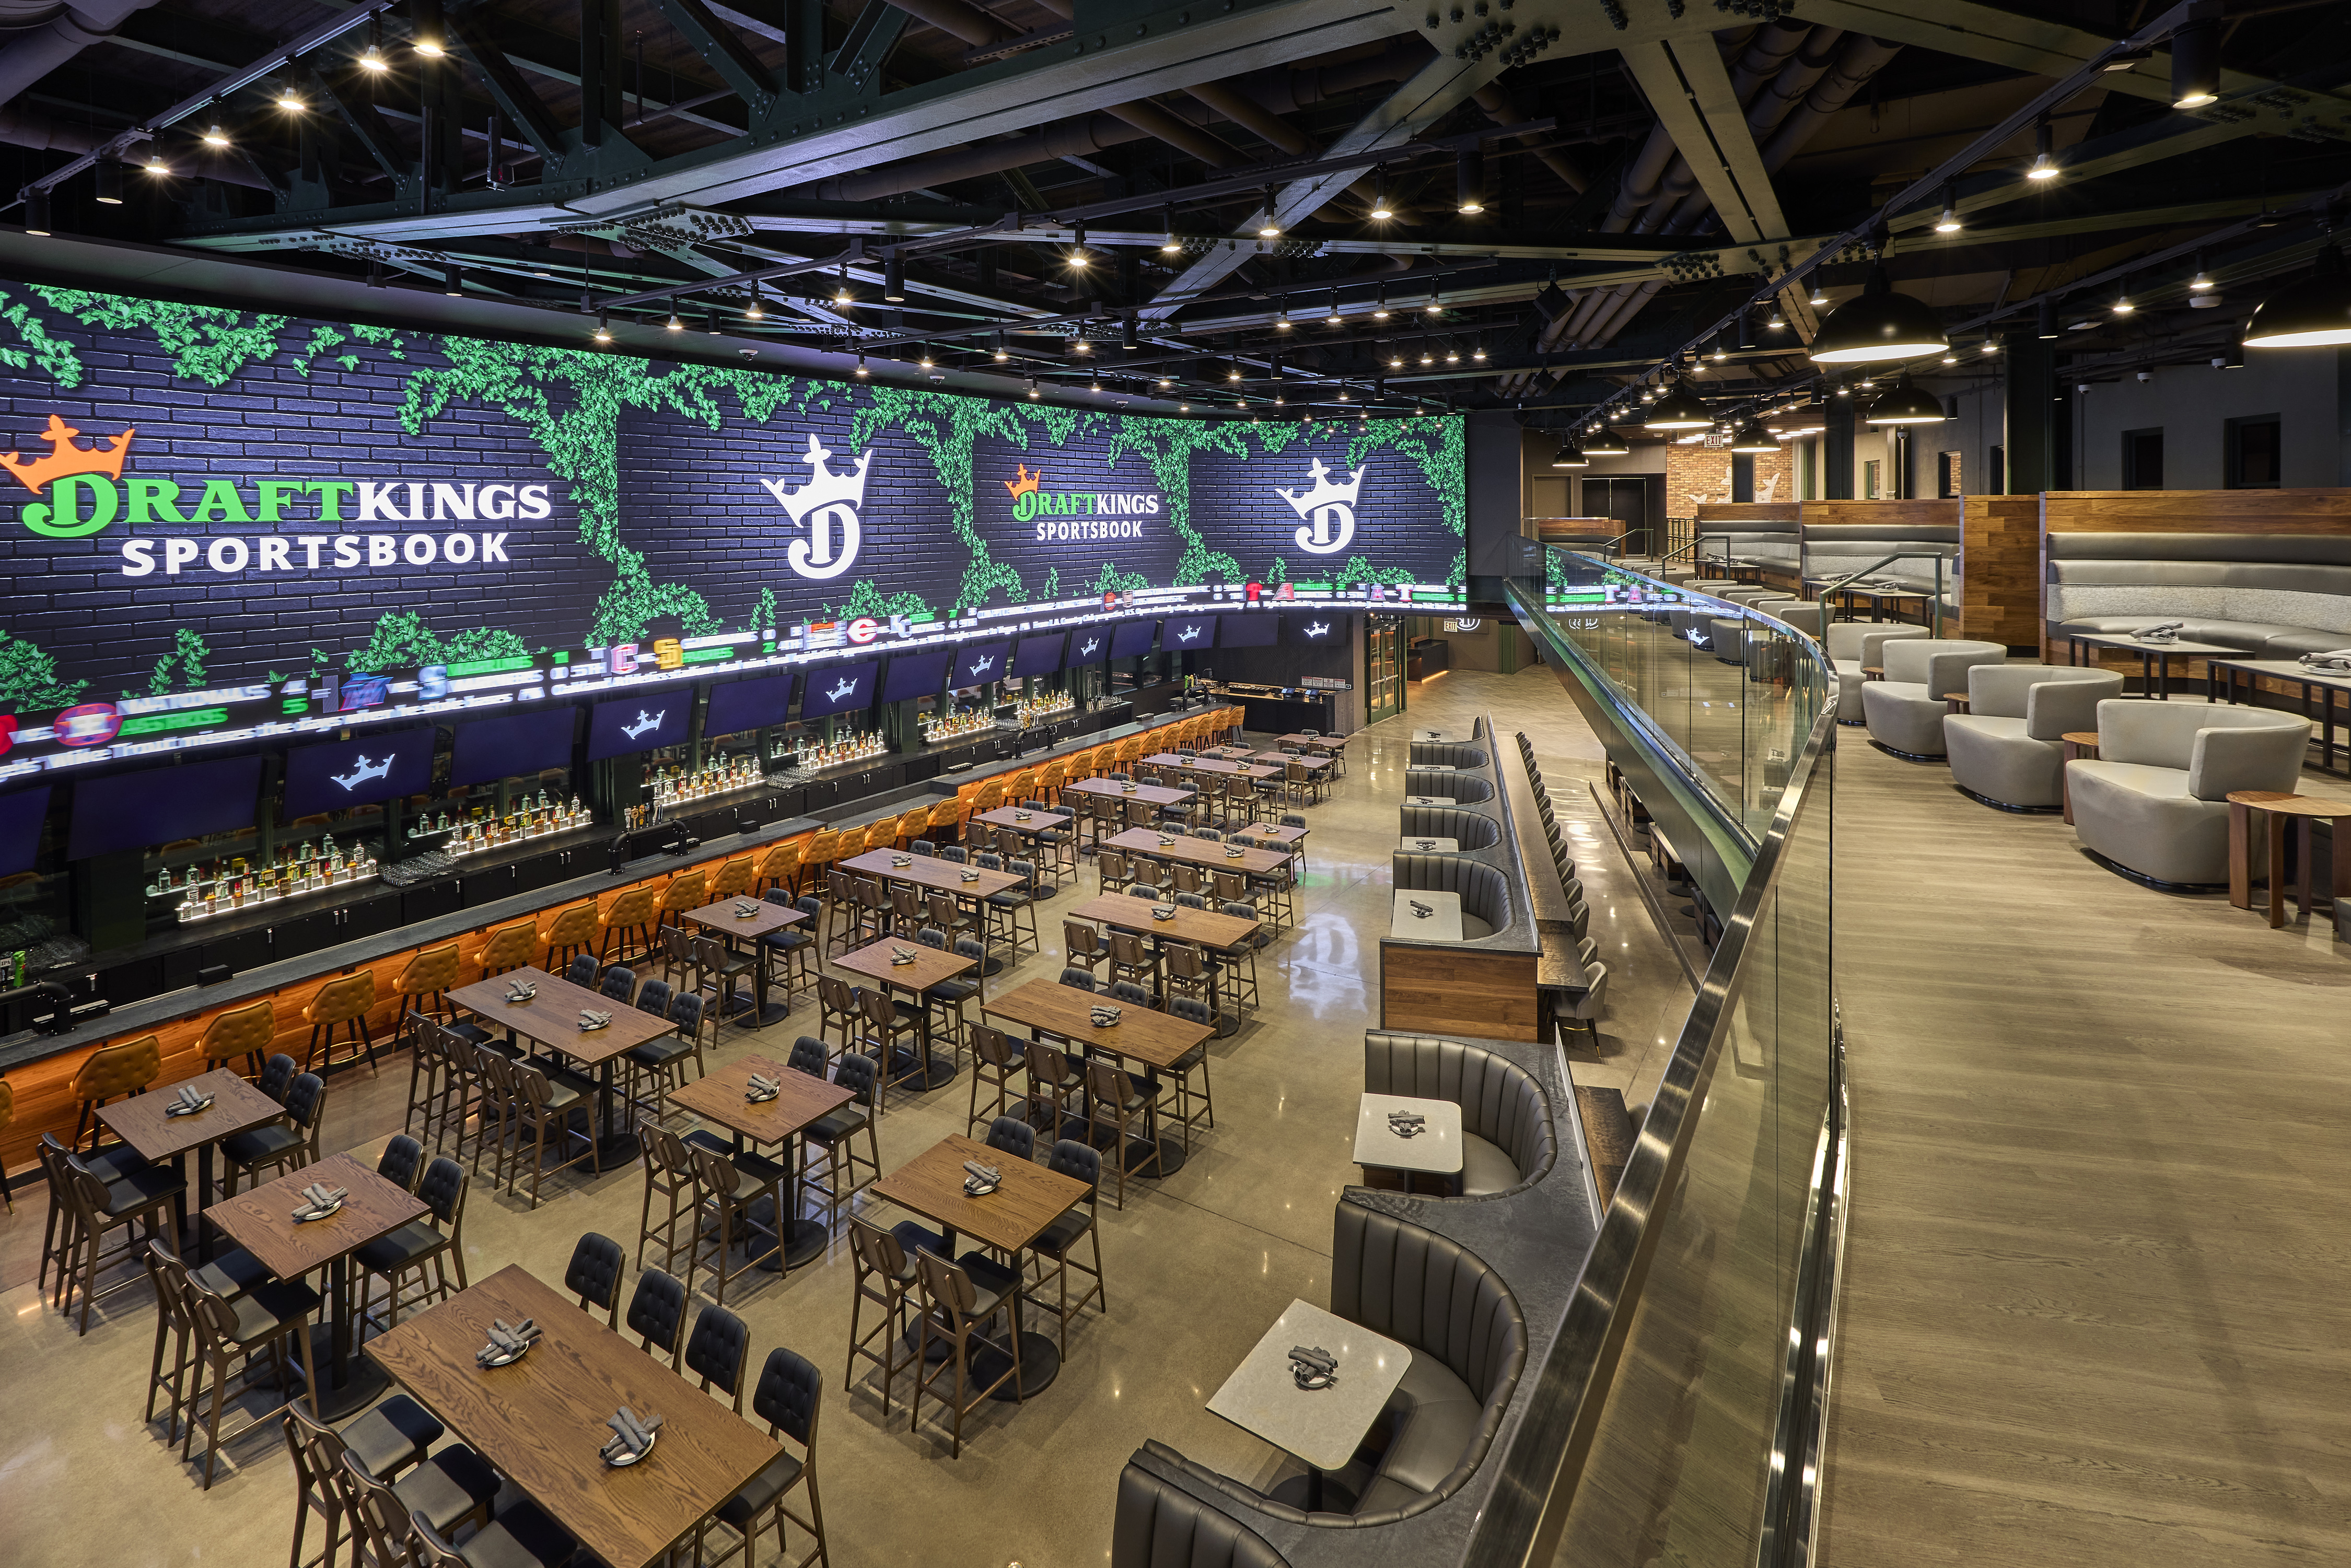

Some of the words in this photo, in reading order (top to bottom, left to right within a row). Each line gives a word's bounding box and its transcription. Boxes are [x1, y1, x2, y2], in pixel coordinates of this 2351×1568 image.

[1706, 435, 1721, 444] EXIT
[22, 474, 551, 537] DRAFTKINGS
[1012, 490, 1159, 522] DRAFTKINGS
[1037, 520, 1143, 541] SPORTSBOOK
[121, 532, 510, 577] SPORTSBOOK
[762, 641, 776, 653] 2
[282, 697, 309, 714] 5
